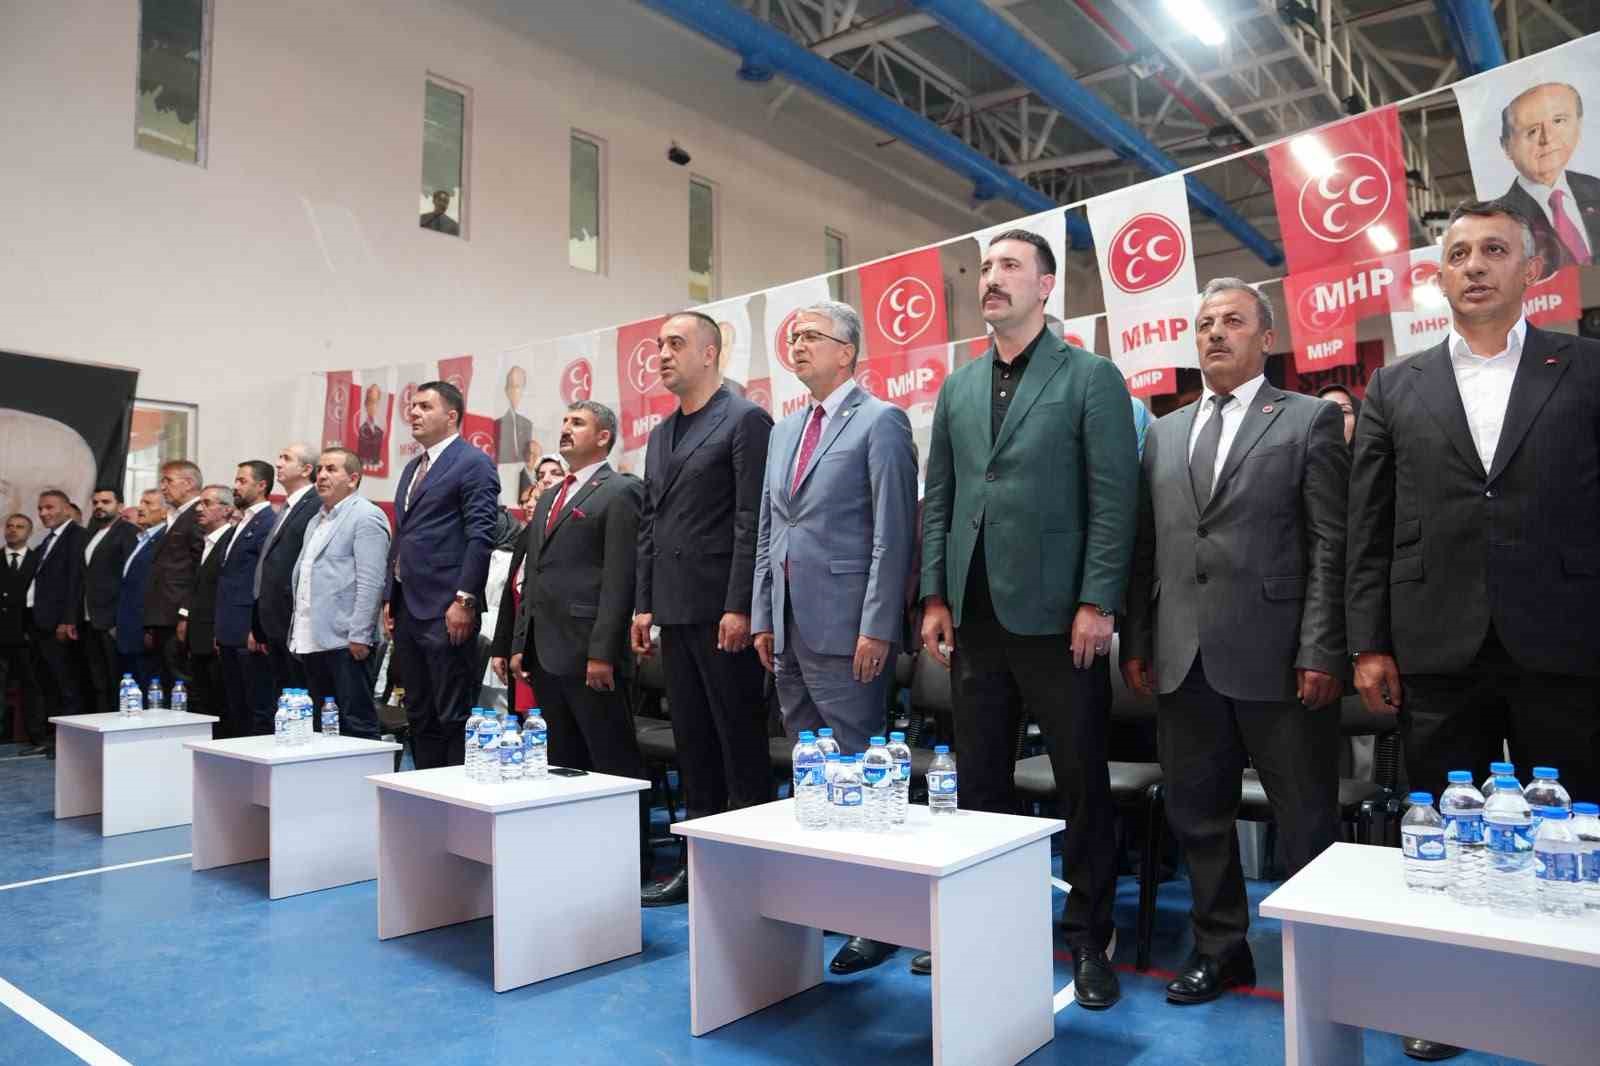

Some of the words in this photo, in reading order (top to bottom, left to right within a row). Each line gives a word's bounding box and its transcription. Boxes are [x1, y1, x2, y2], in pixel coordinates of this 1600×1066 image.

[1315, 268, 1394, 312] MHP
[1522, 294, 1563, 316] MHP
[1122, 317, 1188, 353] MHP
[1410, 317, 1449, 335] MHP
[1307, 339, 1344, 360] MHP
[887, 368, 933, 398] MHP
[1131, 370, 1163, 389] MHP
